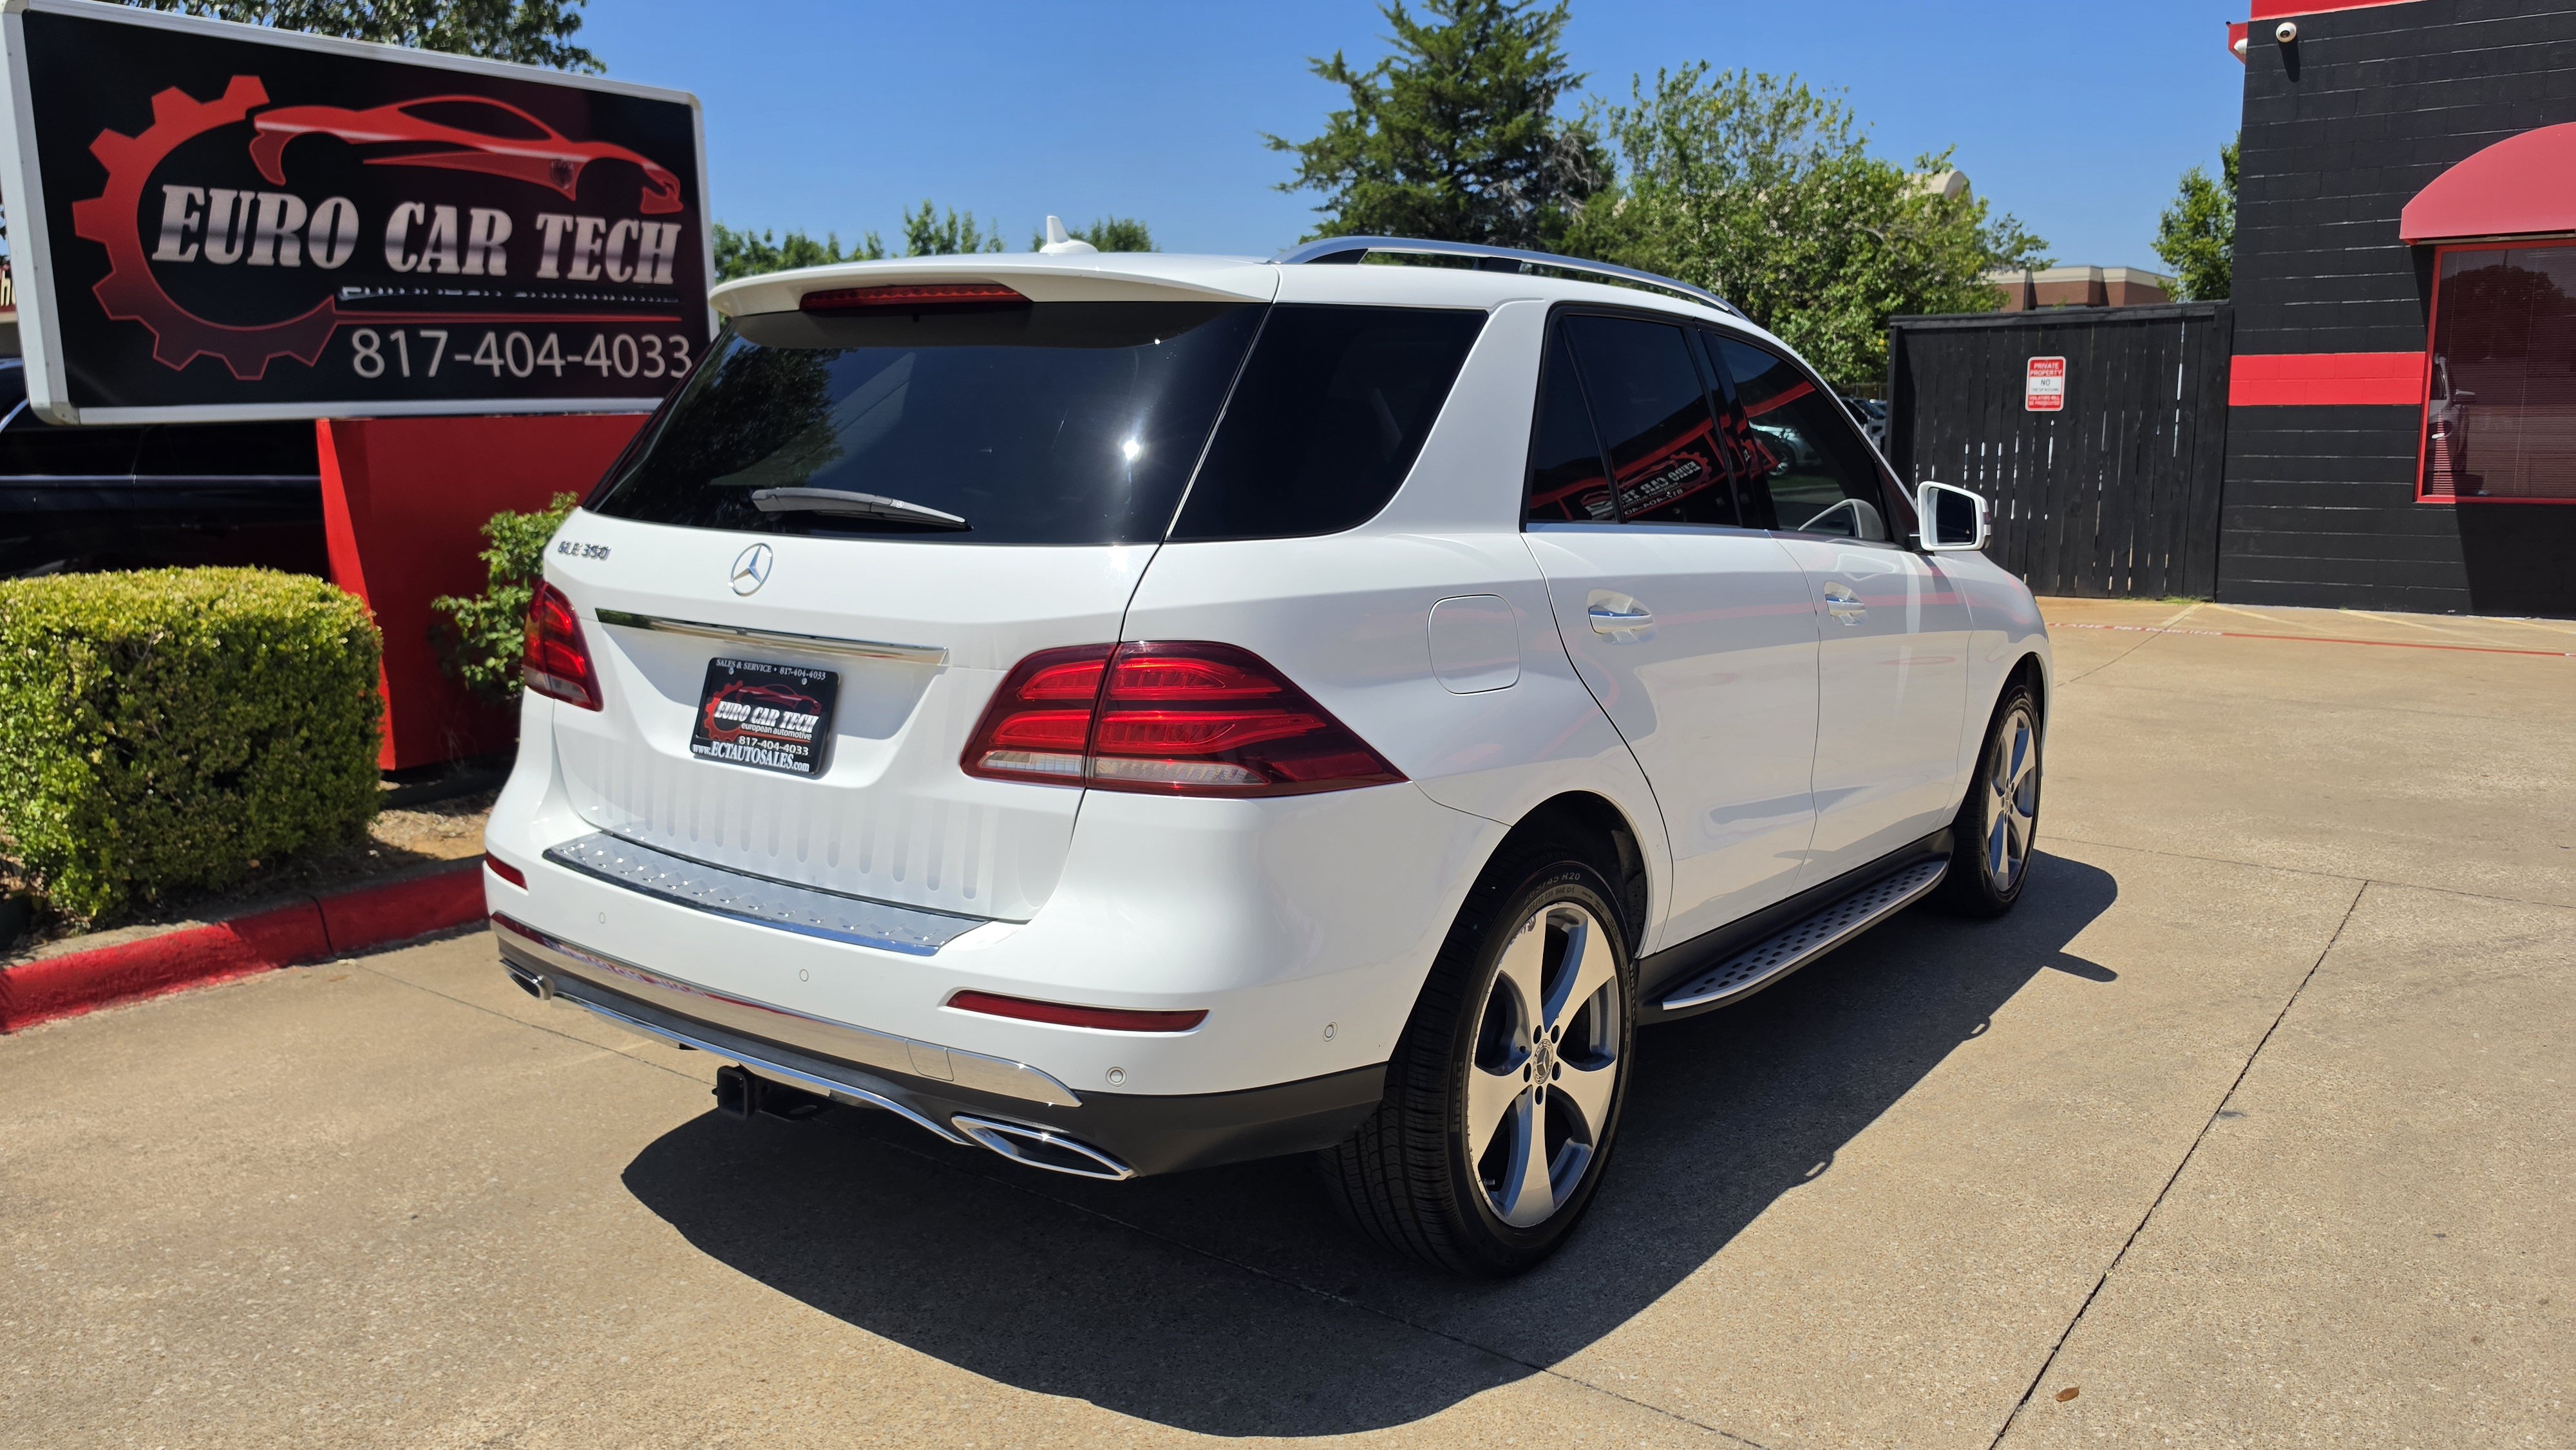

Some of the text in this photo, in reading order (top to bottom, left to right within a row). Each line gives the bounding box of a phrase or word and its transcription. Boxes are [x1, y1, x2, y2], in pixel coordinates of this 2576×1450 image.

[151, 185, 683, 285] EURO CAR TECH
[351, 328, 693, 379] 817-404-4033
[558, 541, 611, 560] GLE 350
[716, 659, 736, 668] SALES
[743, 662, 772, 673] SERVICE
[714, 701, 819, 733] EURO CAR TECH
[741, 722, 812, 740] european automotive
[692, 740, 810, 772] www.ECTAUTOSALES.com
[739, 735, 809, 756] 817-404-4033
